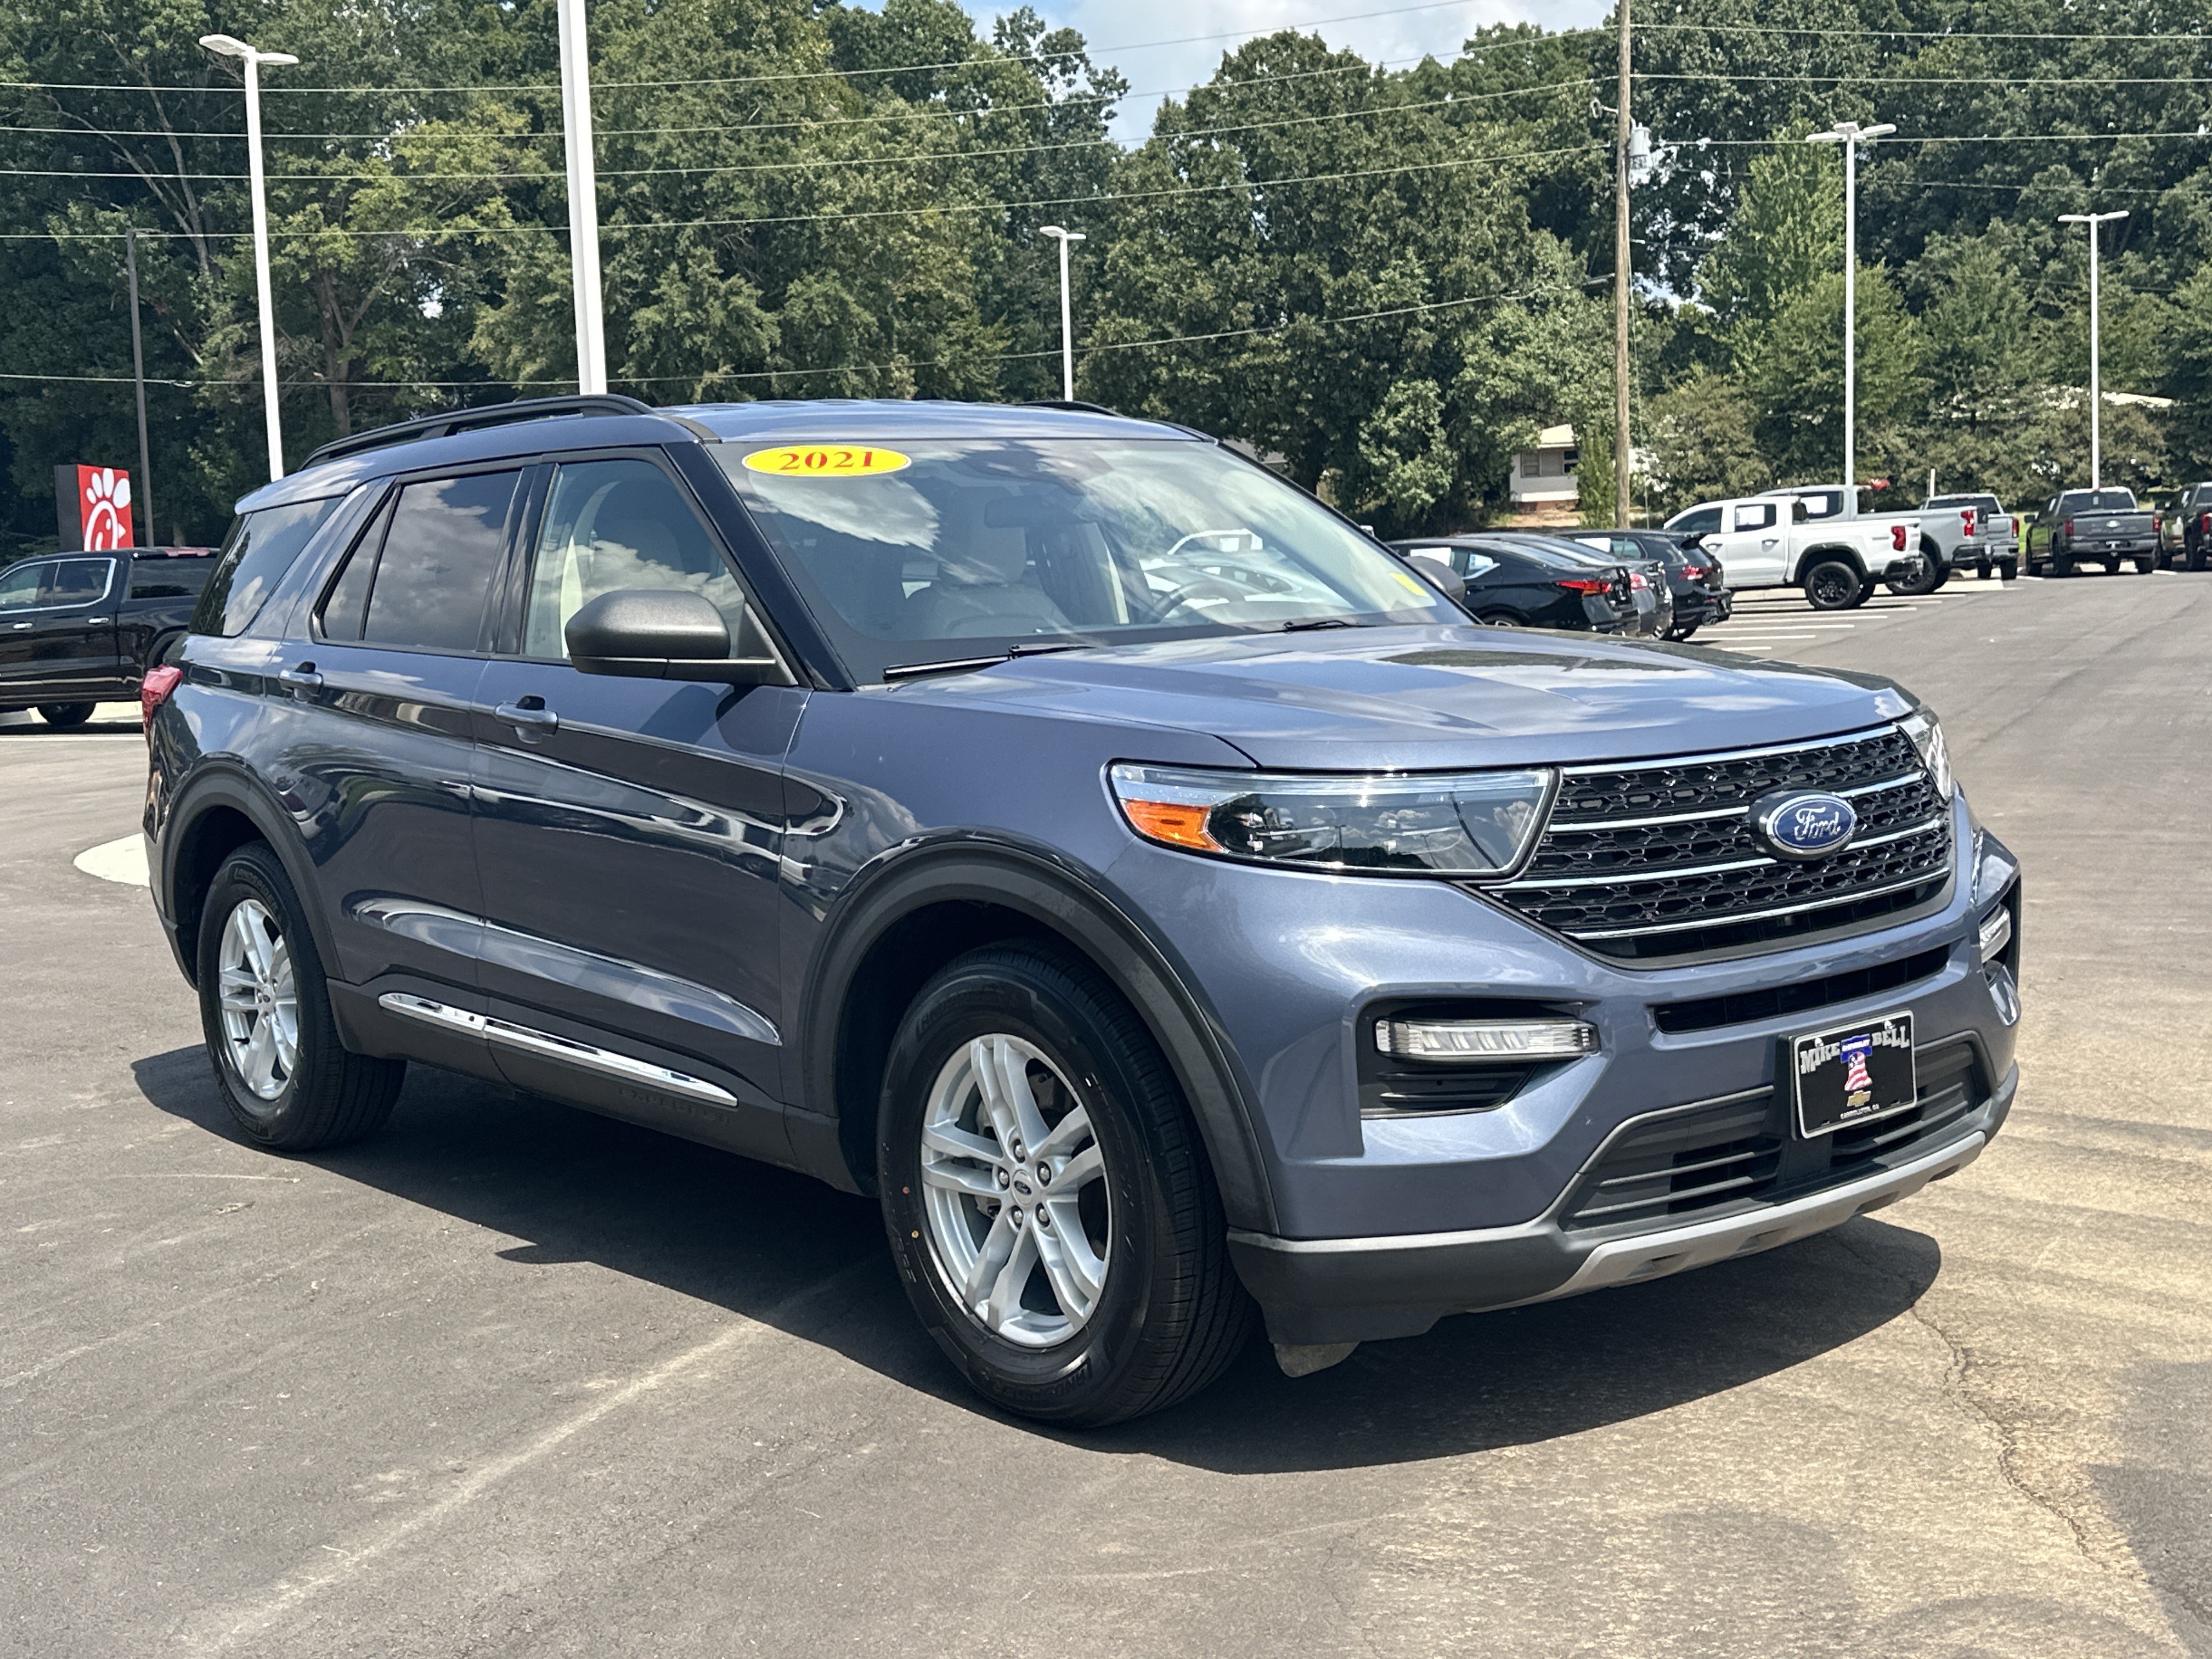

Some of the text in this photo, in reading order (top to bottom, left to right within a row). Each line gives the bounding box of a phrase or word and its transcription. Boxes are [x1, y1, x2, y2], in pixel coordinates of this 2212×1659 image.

[779, 452, 873, 470] 2021
[1794, 806, 1841, 840] Ford
[1799, 1042, 1840, 1074] MIKE
[1872, 1025, 1910, 1048] BELL
